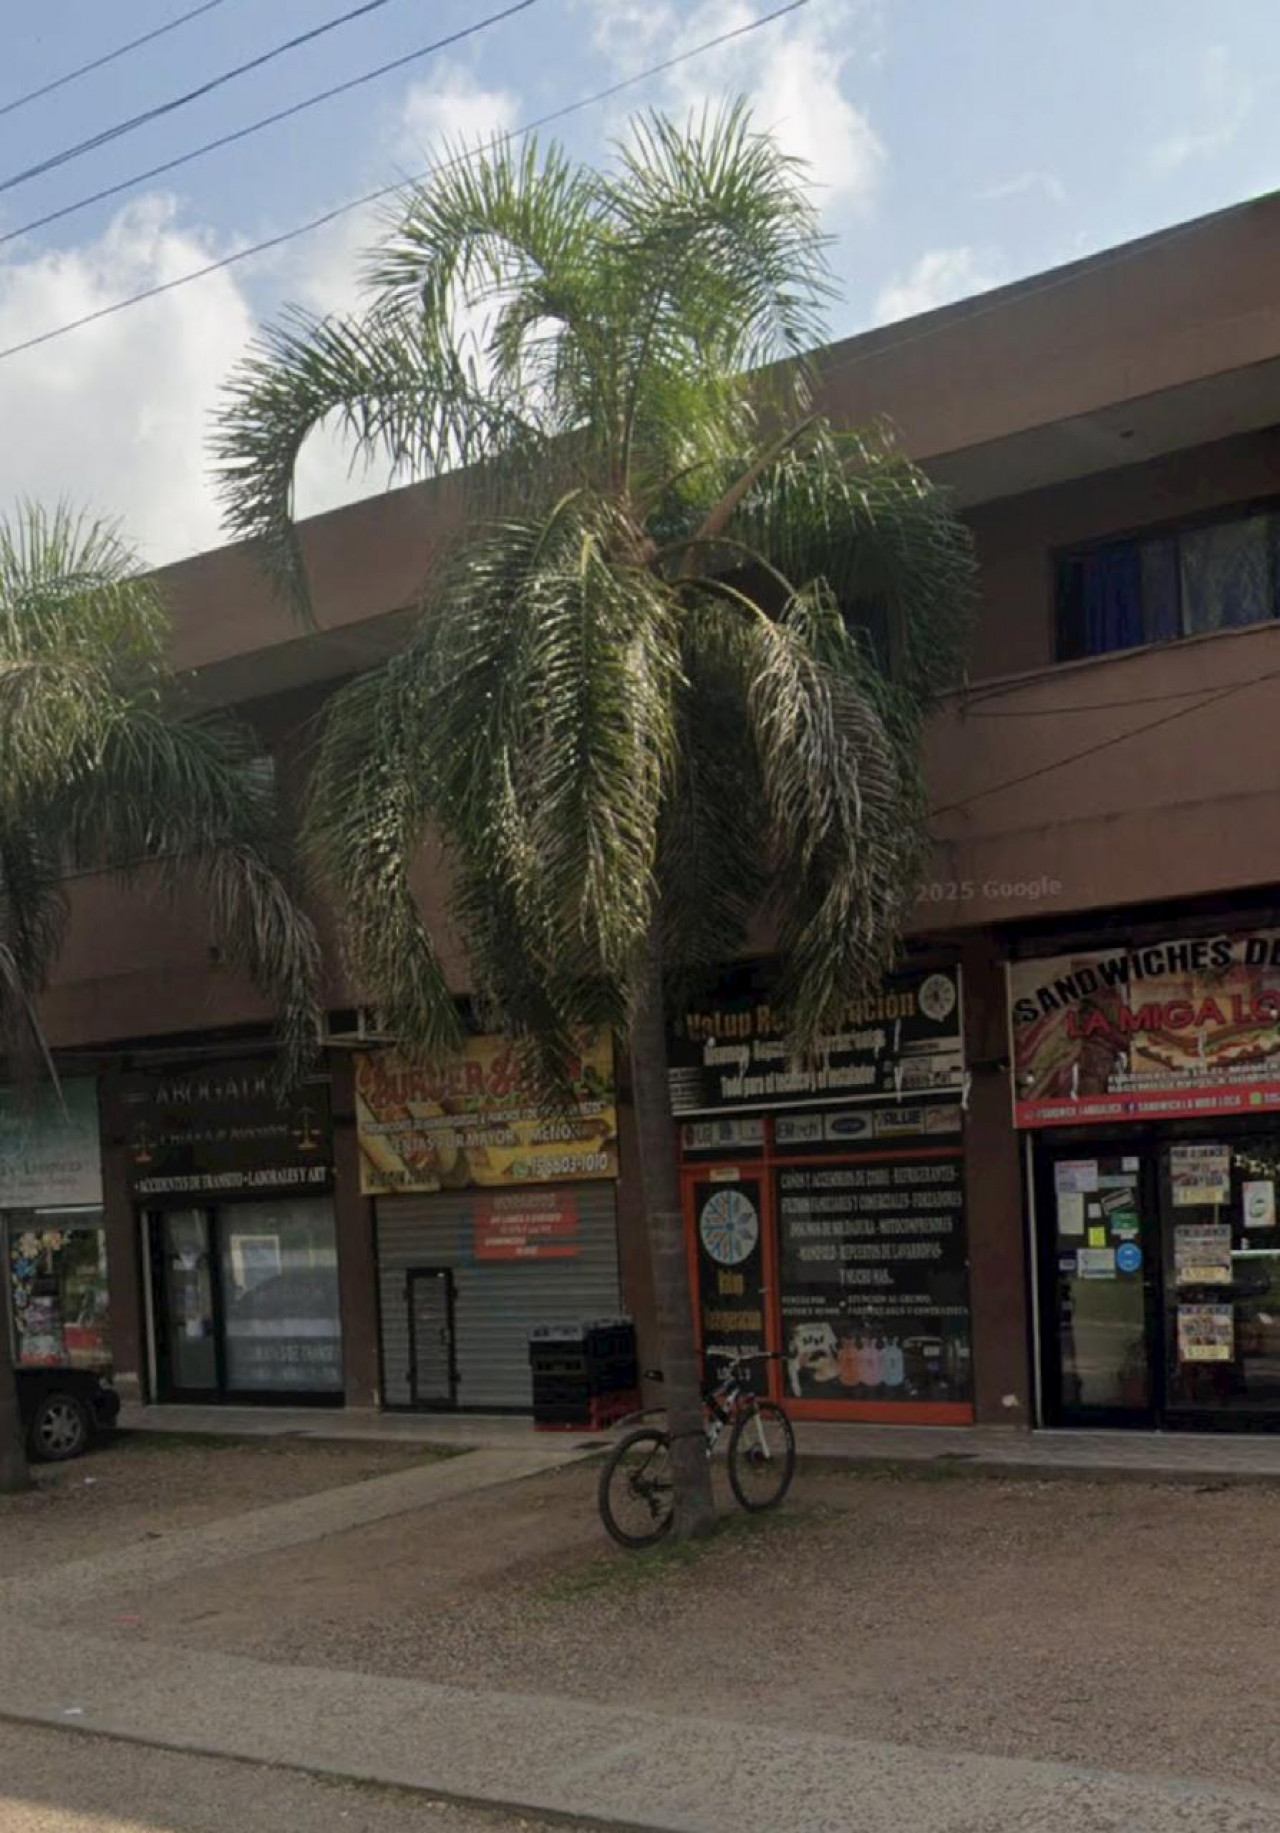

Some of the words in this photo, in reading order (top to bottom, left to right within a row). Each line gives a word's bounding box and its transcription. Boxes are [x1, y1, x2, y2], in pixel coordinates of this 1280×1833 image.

[1014, 937, 1231, 1022] SANDWICHES
[1064, 1008, 1113, 1039] LA
[1119, 997, 1225, 1034] MIGA
